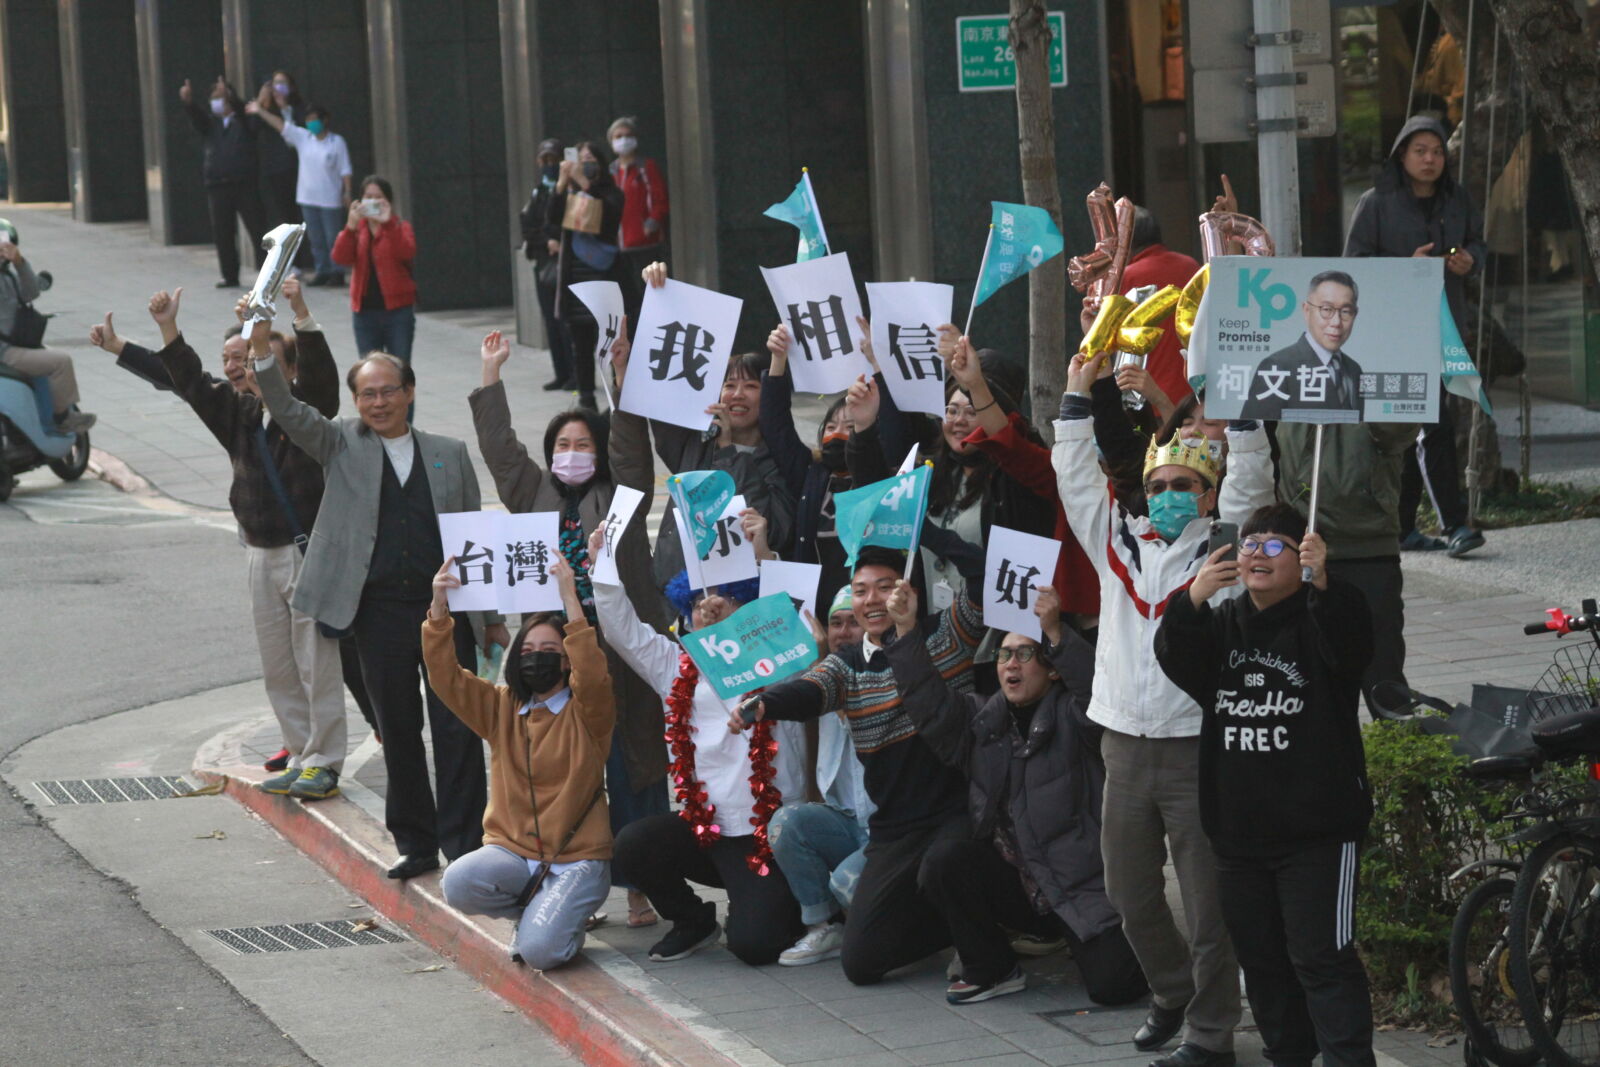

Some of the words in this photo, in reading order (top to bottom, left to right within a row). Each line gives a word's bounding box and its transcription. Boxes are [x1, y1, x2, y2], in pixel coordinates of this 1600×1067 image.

[963, 55, 985, 64] Lane
[788, 294, 854, 361] 相
[1218, 332, 1271, 343] Promise
[1219, 318, 1250, 331] Keep
[649, 320, 716, 391] 我
[888, 322, 944, 382] 信
[1444, 344, 1468, 356] Kee
[1216, 363, 1330, 402] 柯文哲
[995, 558, 1041, 610] 好
